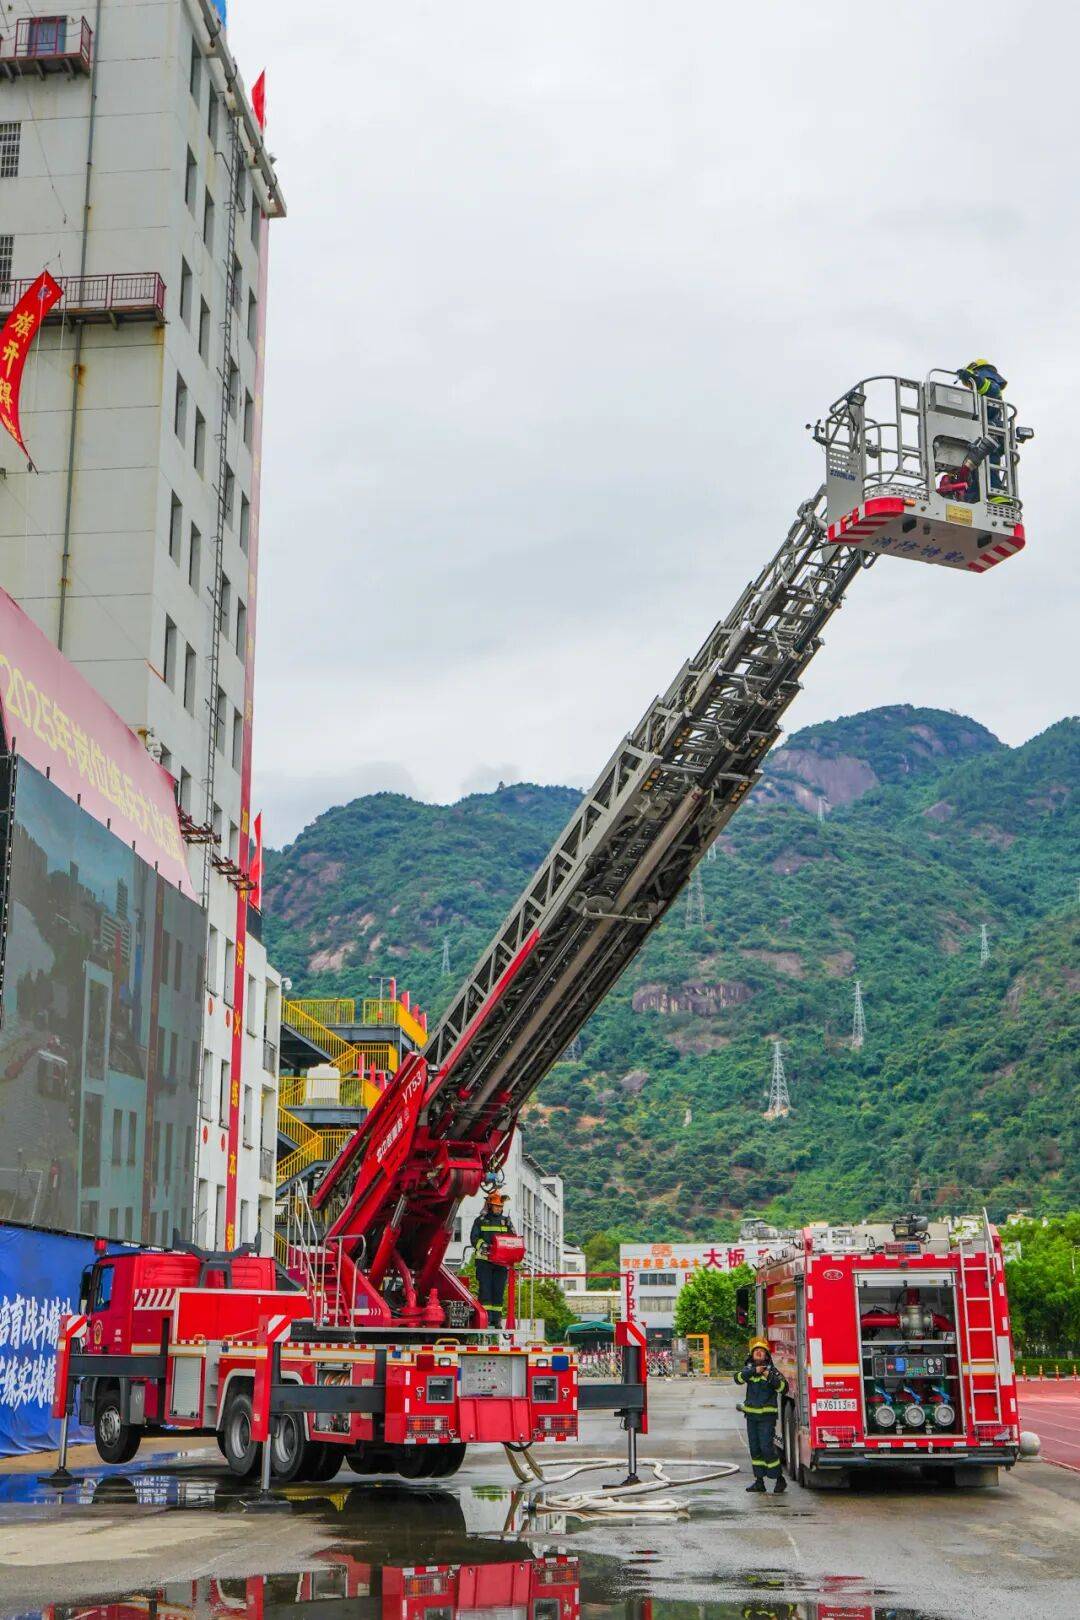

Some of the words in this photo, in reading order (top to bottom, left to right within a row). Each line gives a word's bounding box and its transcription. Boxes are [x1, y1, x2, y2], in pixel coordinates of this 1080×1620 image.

[403, 1071, 422, 1104] YT53
[0, 1293, 73, 1350] 培育战斗精
